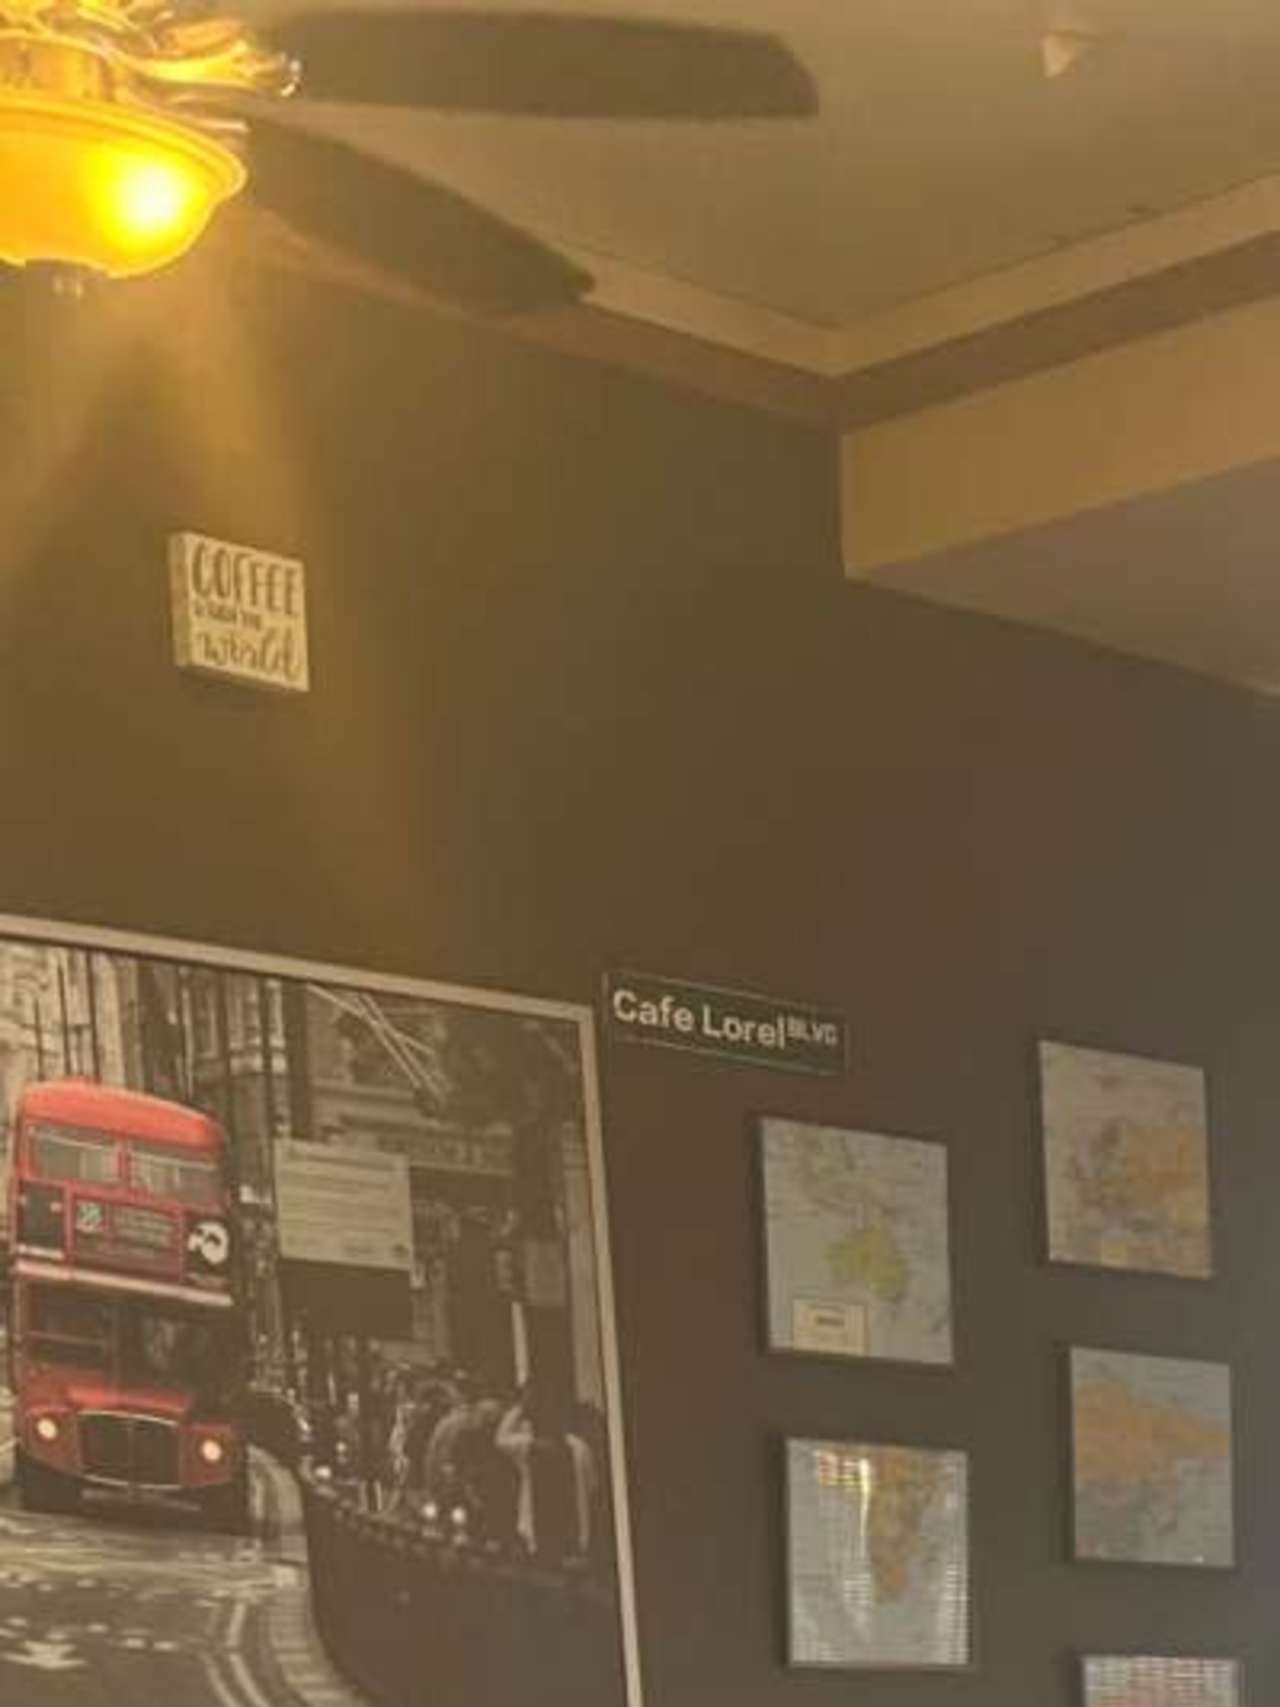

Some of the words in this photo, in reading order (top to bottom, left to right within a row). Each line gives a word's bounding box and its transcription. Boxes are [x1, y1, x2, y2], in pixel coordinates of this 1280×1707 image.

[191, 541, 299, 618] COFFEE
[613, 988, 696, 1033] Cafe
[702, 1003, 786, 1050] Lorel
